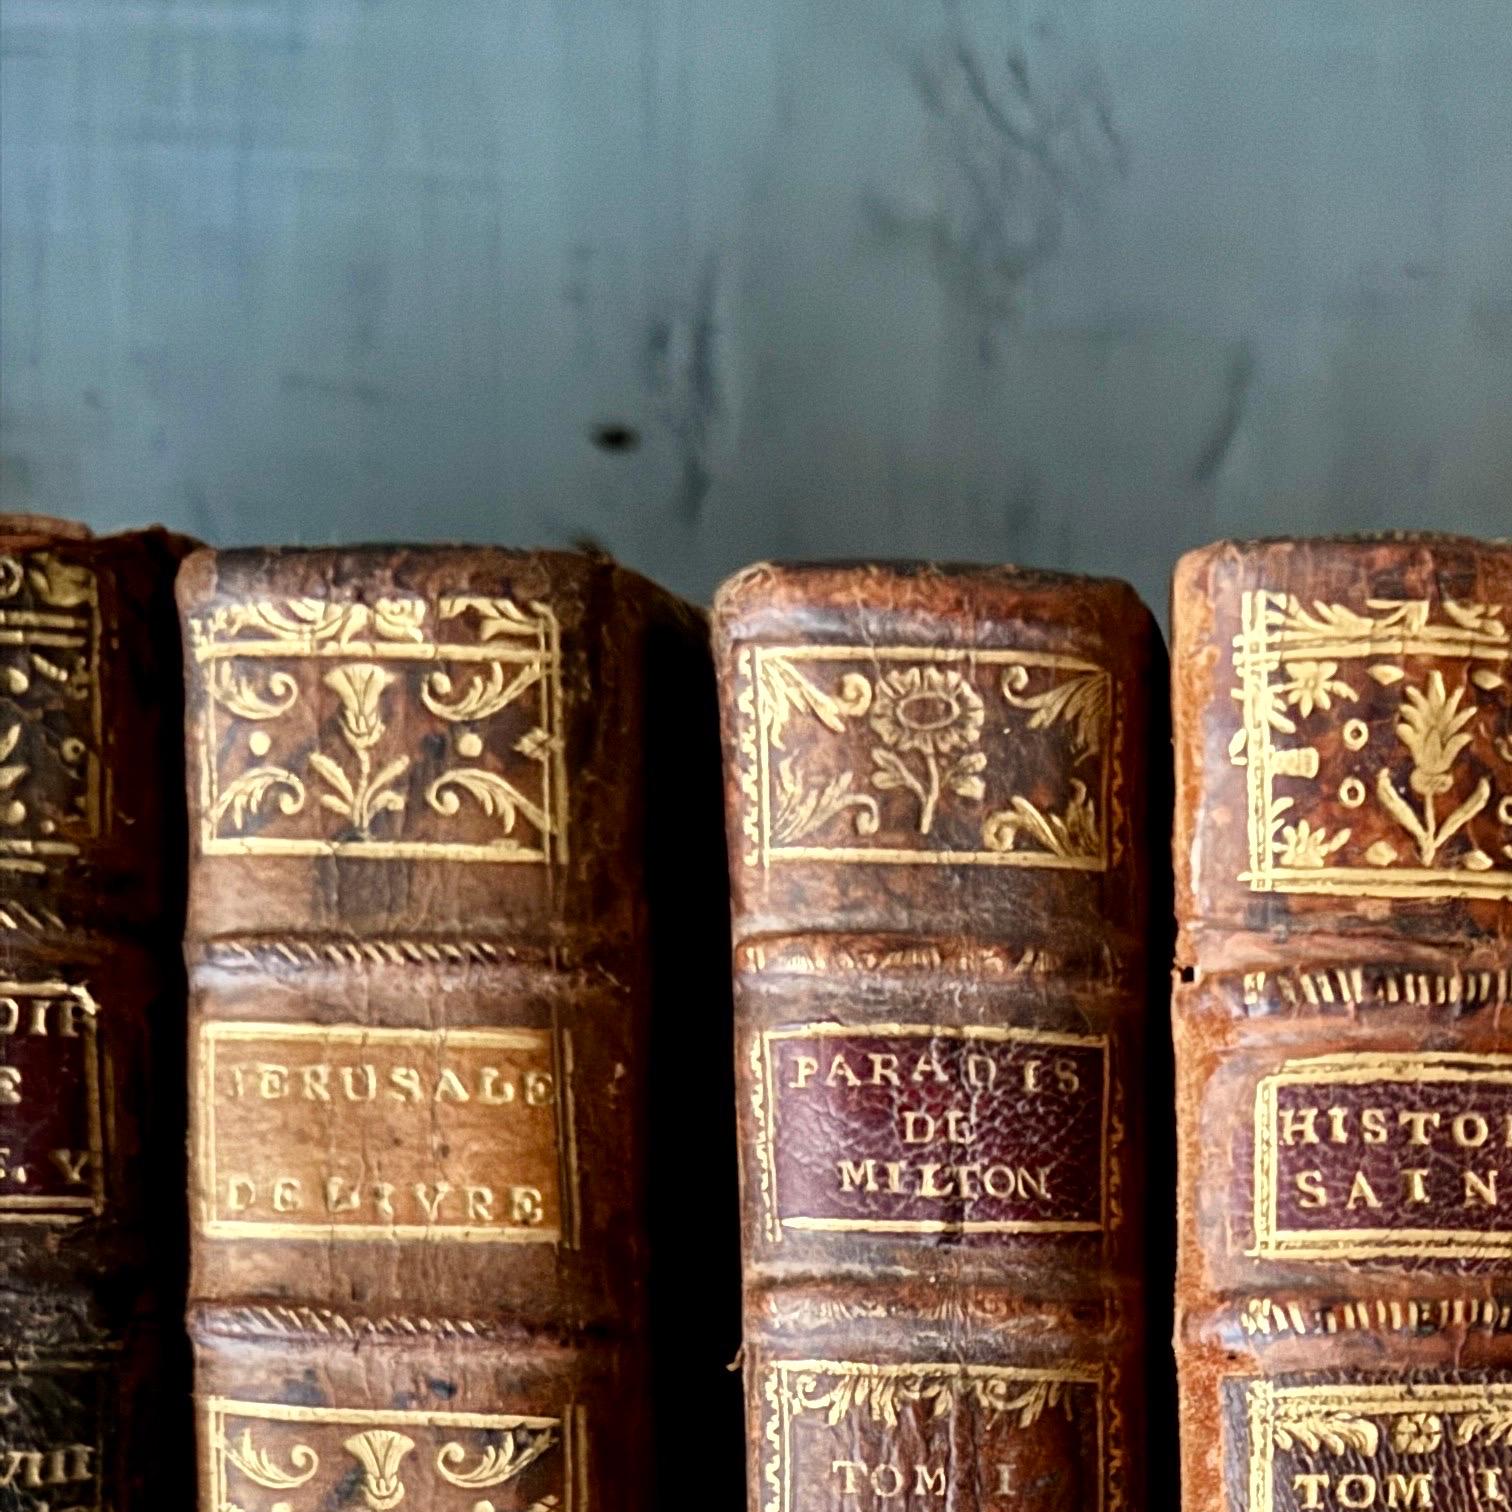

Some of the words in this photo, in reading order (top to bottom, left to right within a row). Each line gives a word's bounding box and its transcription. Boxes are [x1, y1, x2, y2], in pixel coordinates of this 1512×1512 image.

[788, 1053, 1080, 1094] PARADIS
[903, 1110, 977, 1144] DE
[228, 1175, 543, 1222] DELIVRE
[837, 1159, 1052, 1200] MILTON
[832, 1460, 946, 1497] TOM
[995, 1463, 1016, 1496] I
[1293, 1472, 1433, 1510] TOM
